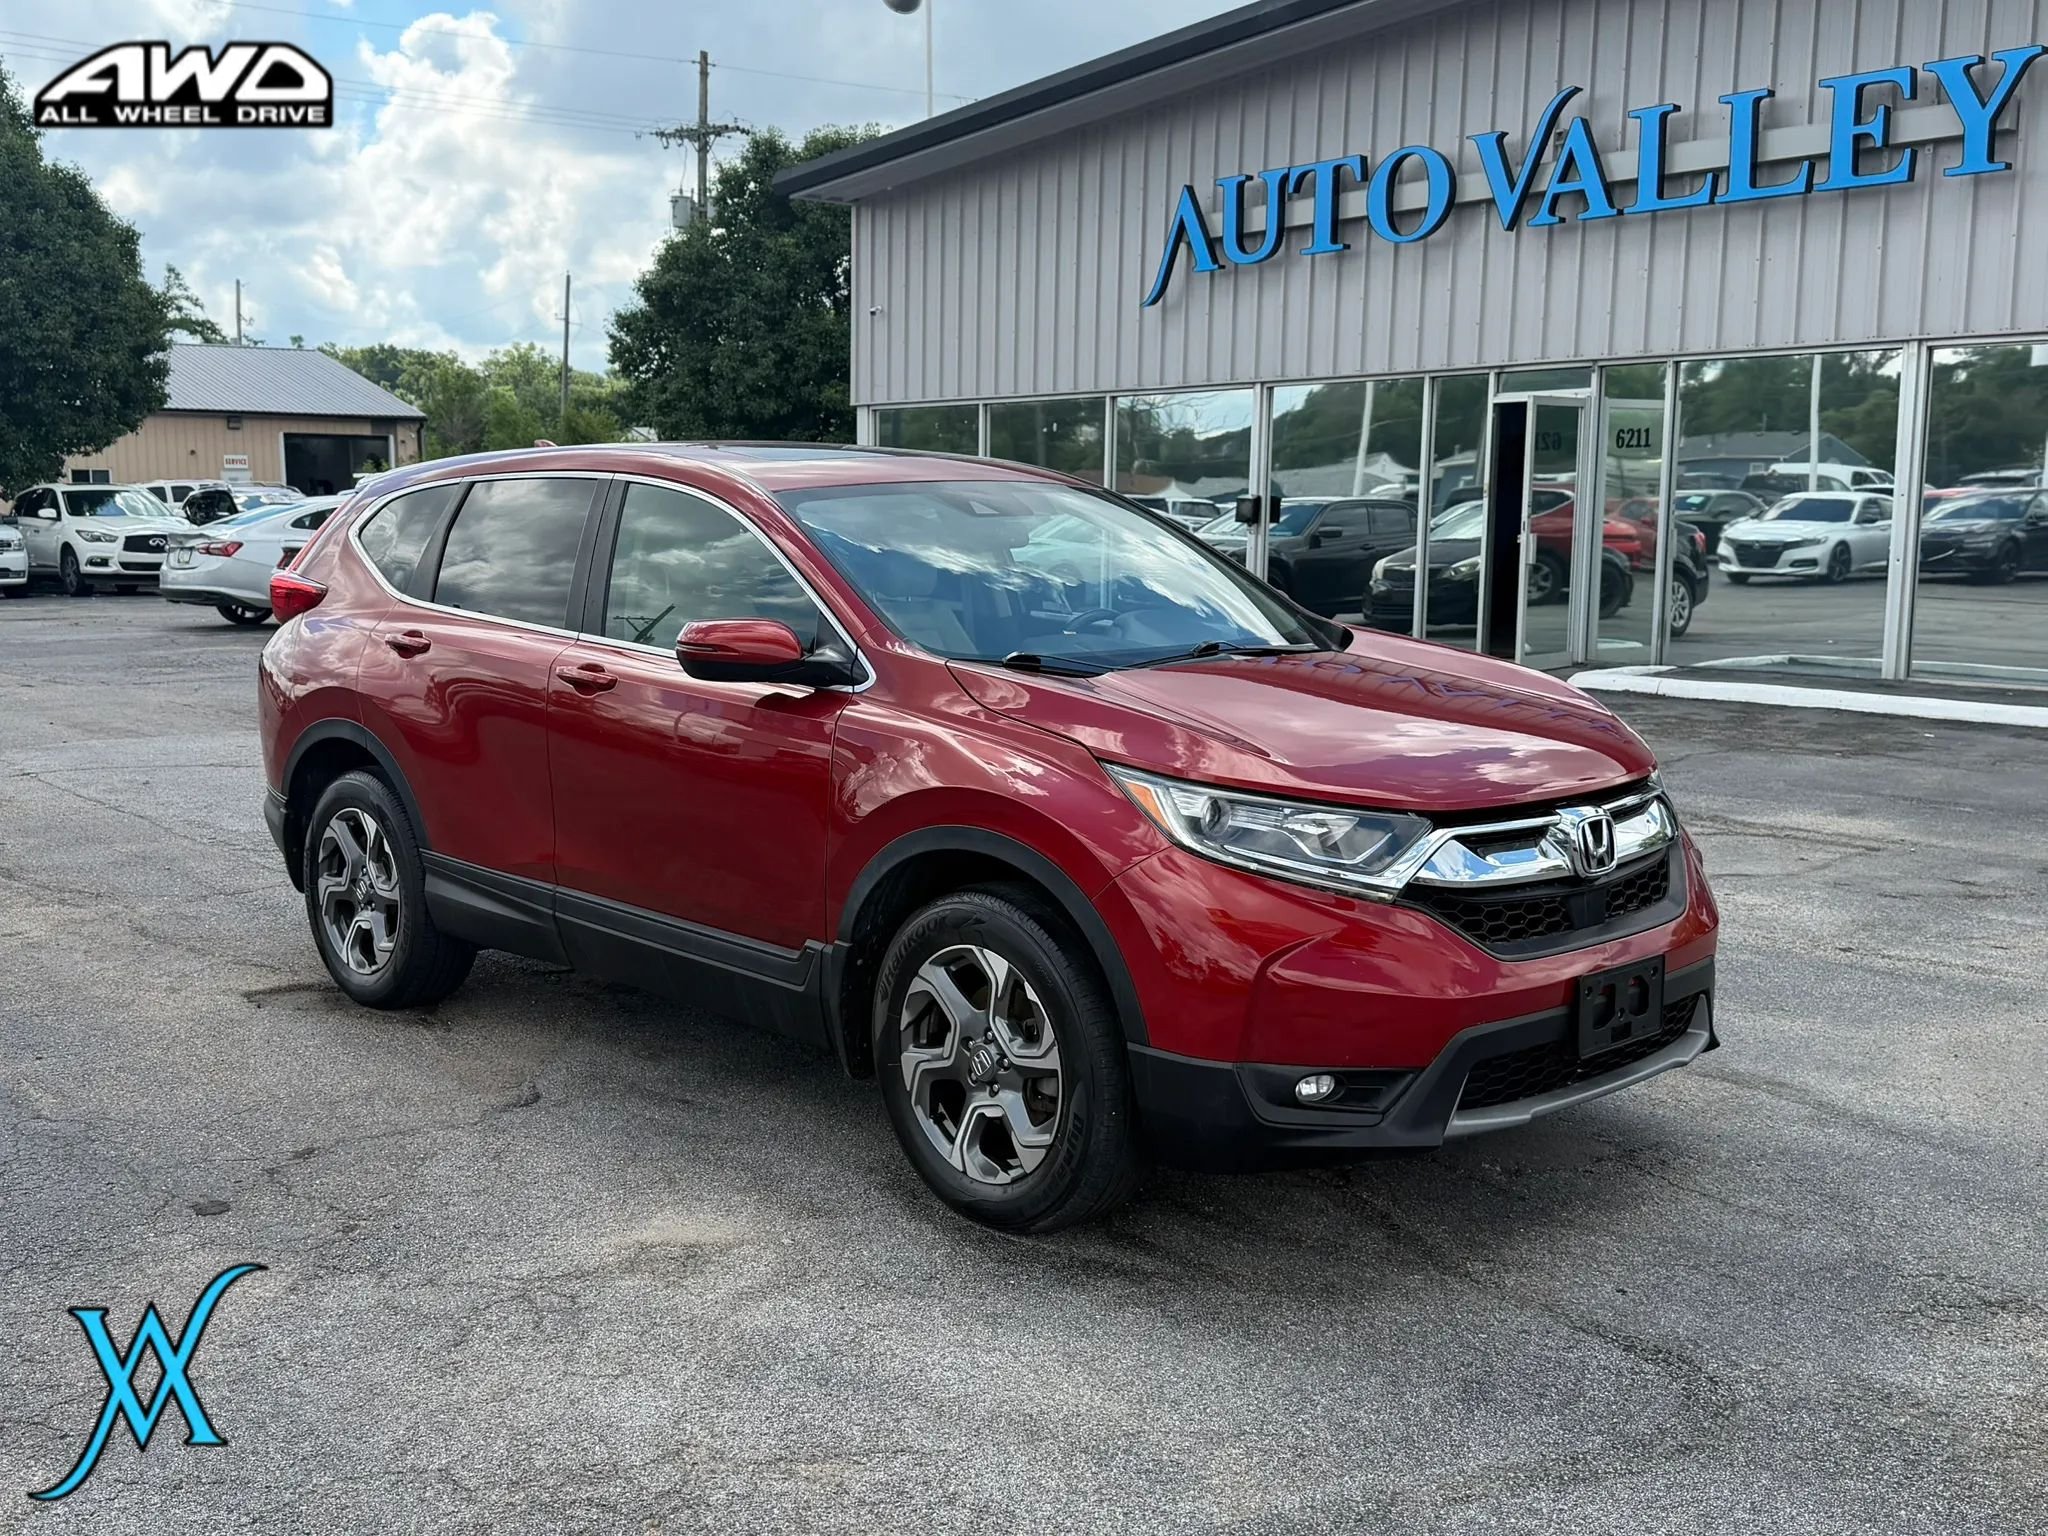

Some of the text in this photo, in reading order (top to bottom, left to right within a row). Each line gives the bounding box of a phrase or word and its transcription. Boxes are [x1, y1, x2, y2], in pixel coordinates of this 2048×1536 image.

[1143, 45, 2048, 308] AUTO VALLEY
[1616, 428, 1651, 449] 6211
